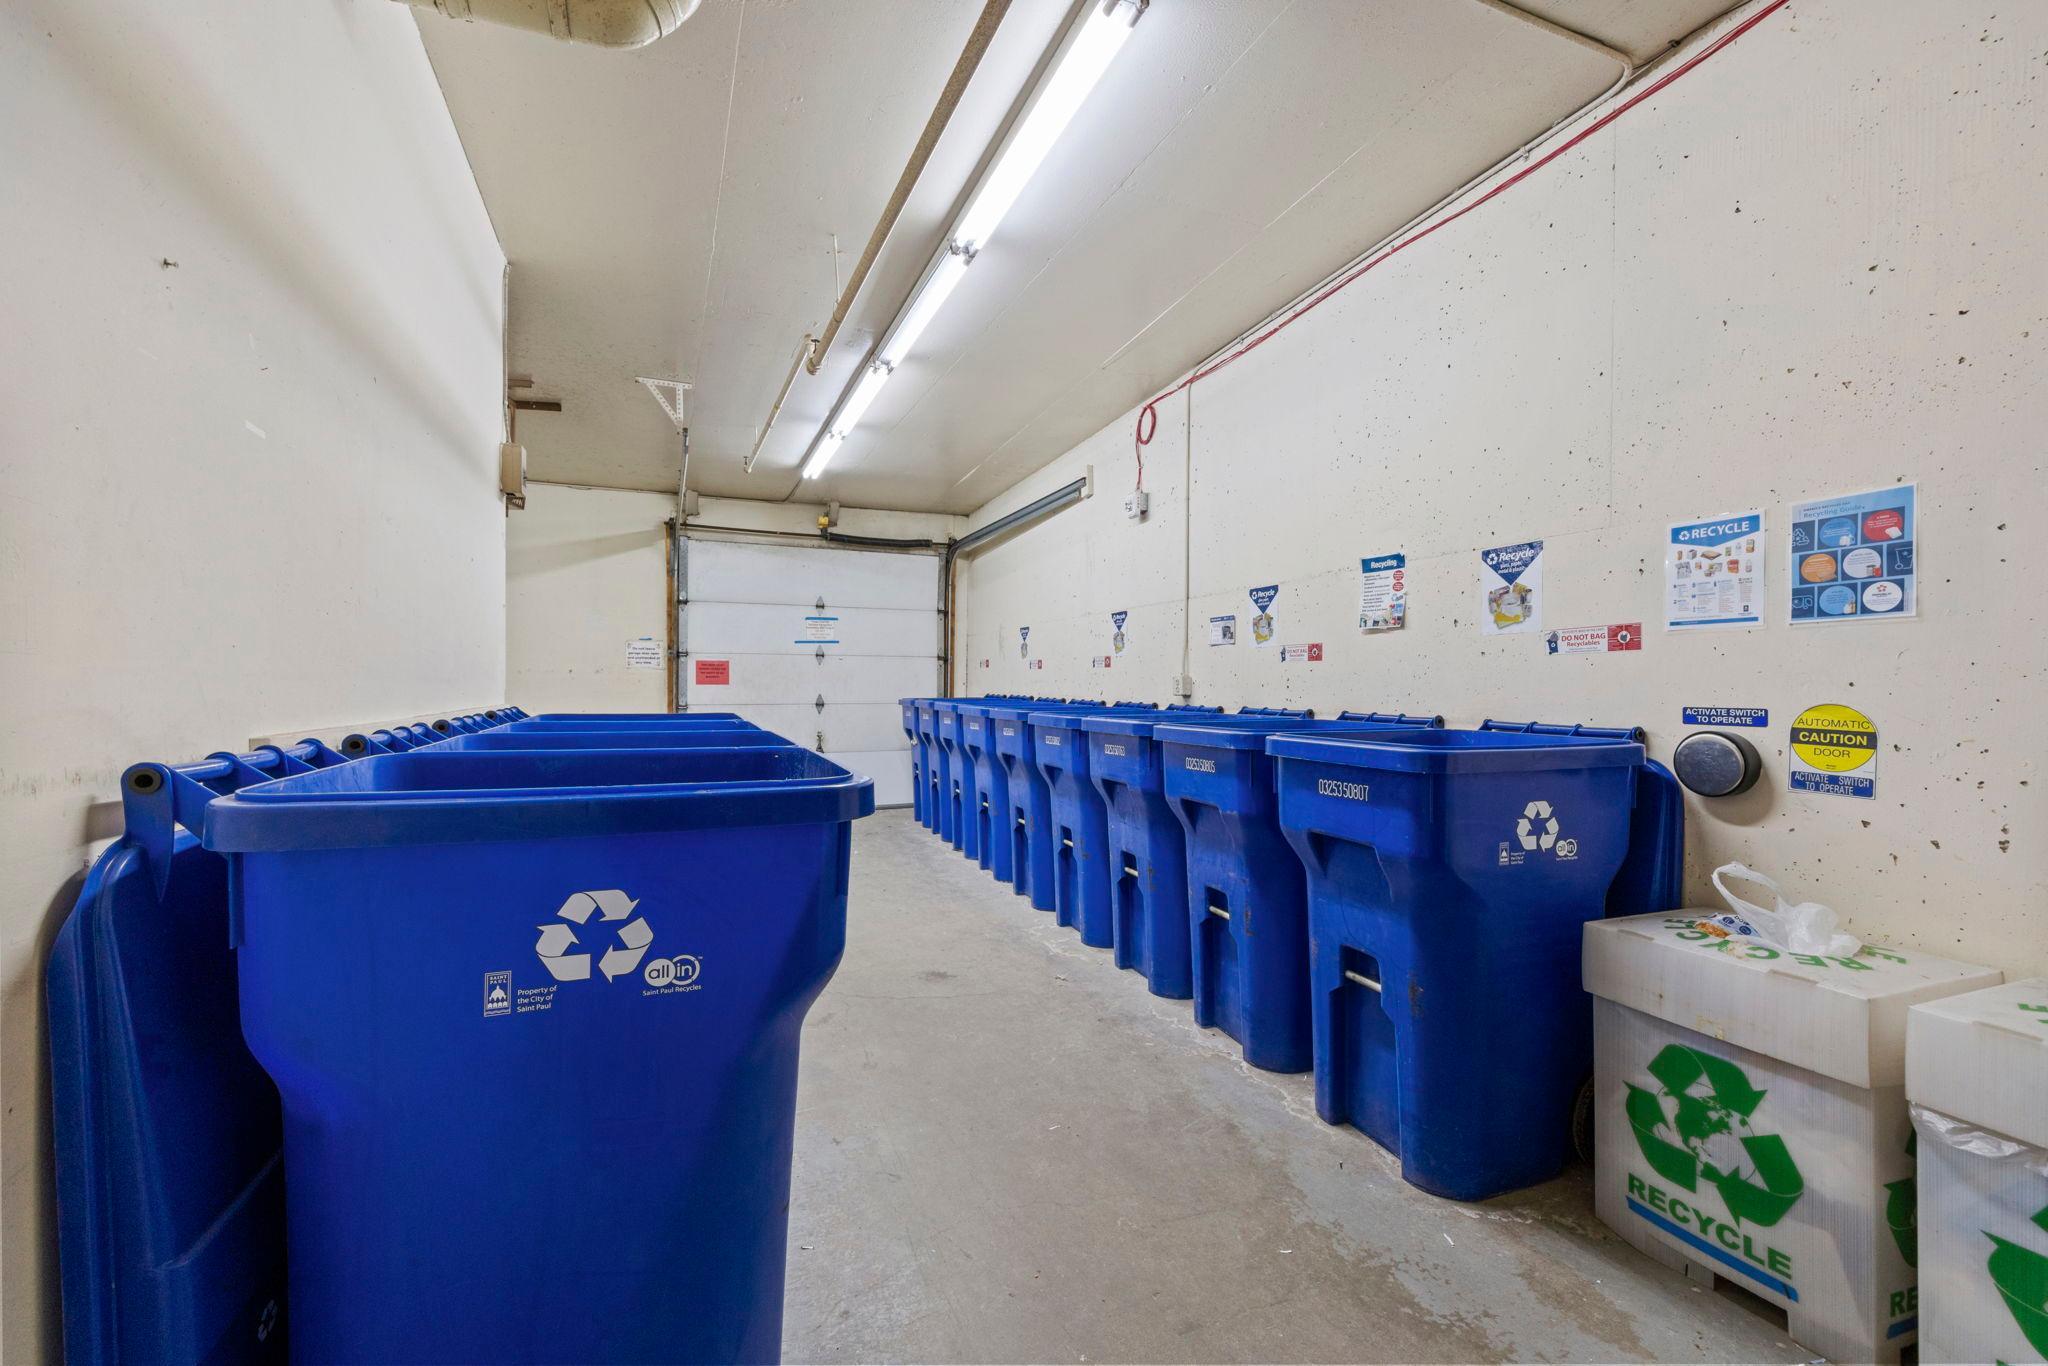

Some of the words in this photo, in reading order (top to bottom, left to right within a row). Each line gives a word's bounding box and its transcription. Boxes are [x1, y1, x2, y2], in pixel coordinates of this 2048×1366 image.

[1691, 521, 1750, 539] RECYCLE
[1500, 548, 1534, 562] Recycle
[1370, 559, 1397, 569] Recycling
[1686, 708, 1728, 716] ACTIVATE
[1729, 709, 1765, 717] SWITCH
[1710, 716, 1753, 725] OPERATE
[1798, 717, 1870, 730] AUTOMATIC
[1799, 731, 1868, 746] CAUTION
[1813, 747, 1851, 758] DOOR
[1794, 773, 1829, 784] ACTIVATE
[1838, 777, 1869, 787] SWITCH
[1805, 783, 1815, 791] TO
[1819, 783, 1854, 795] OPERATE
[648, 964, 669, 979] all
[677, 963, 692, 977] in
[517, 987, 548, 996] Property
[675, 984, 702, 992] Recycles
[517, 1005, 535, 1013] Saint
[1628, 1172, 1792, 1280] RECYCLE
